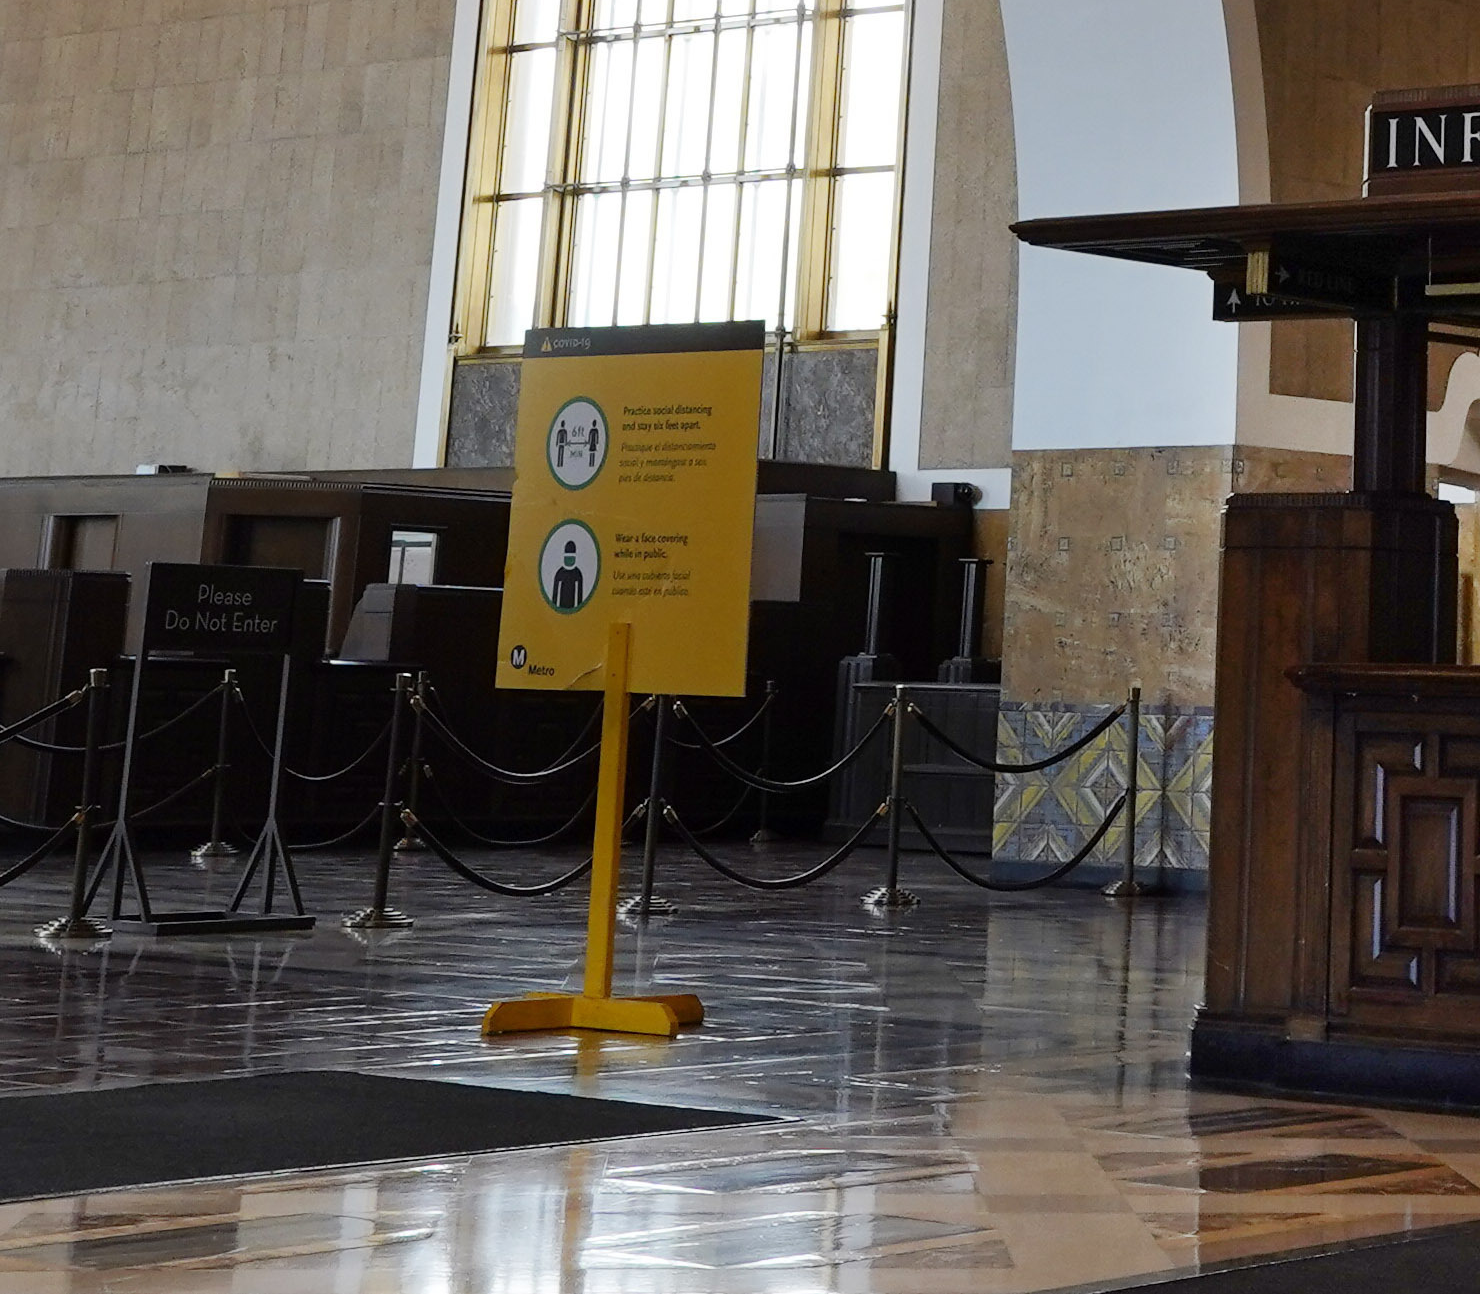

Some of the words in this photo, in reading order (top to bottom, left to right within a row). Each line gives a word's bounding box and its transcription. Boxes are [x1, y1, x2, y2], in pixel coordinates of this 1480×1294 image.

[553, 337, 592, 350] COVID-19
[623, 405, 652, 416] Practice
[653, 405, 674, 415] social
[675, 404, 713, 417] distancing
[572, 425, 585, 438] 6ft
[622, 422, 636, 431] and
[637, 422, 652, 432] stay
[666, 420, 679, 431] feet
[641, 532, 656, 543] face
[657, 532, 689, 547] covering
[198, 584, 252, 605] Please
[165, 609, 190, 630] Do
[195, 611, 227, 632] Not
[232, 612, 278, 633] Enter
[512, 648, 526, 666] M
[528, 664, 555, 677] Metro
